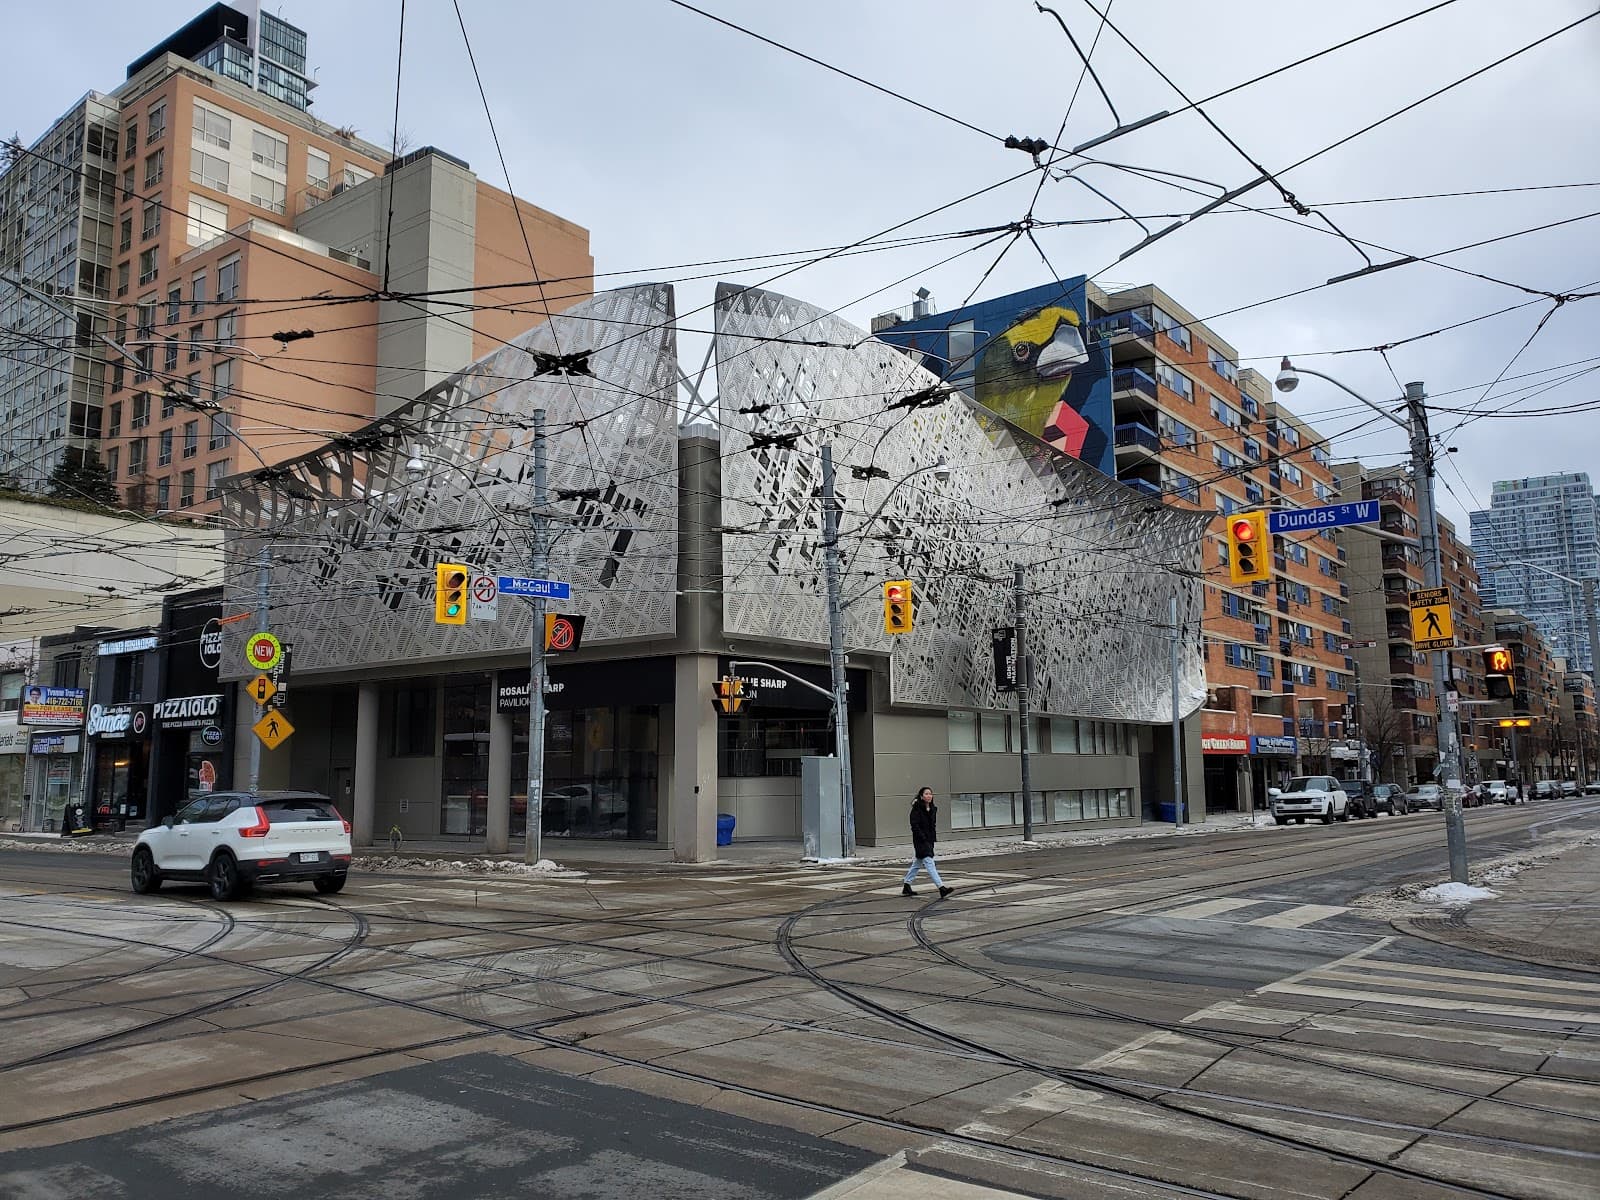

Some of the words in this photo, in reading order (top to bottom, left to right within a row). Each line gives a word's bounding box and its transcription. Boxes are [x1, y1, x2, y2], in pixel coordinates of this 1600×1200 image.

[1278, 509, 1336, 528] Dundas
[1341, 505, 1350, 514] St
[1355, 503, 1370, 518] W
[512, 579, 551, 594] McCaul
[1416, 590, 1442, 599] SENIORS
[1410, 599, 1433, 607] SAFETY
[1434, 596, 1449, 604] ZONE
[254, 645, 274, 657] NEW
[1415, 641, 1431, 650] DRIVE
[760, 678, 787, 689] SHARP
[153, 698, 217, 719] PIZZAIOLO
